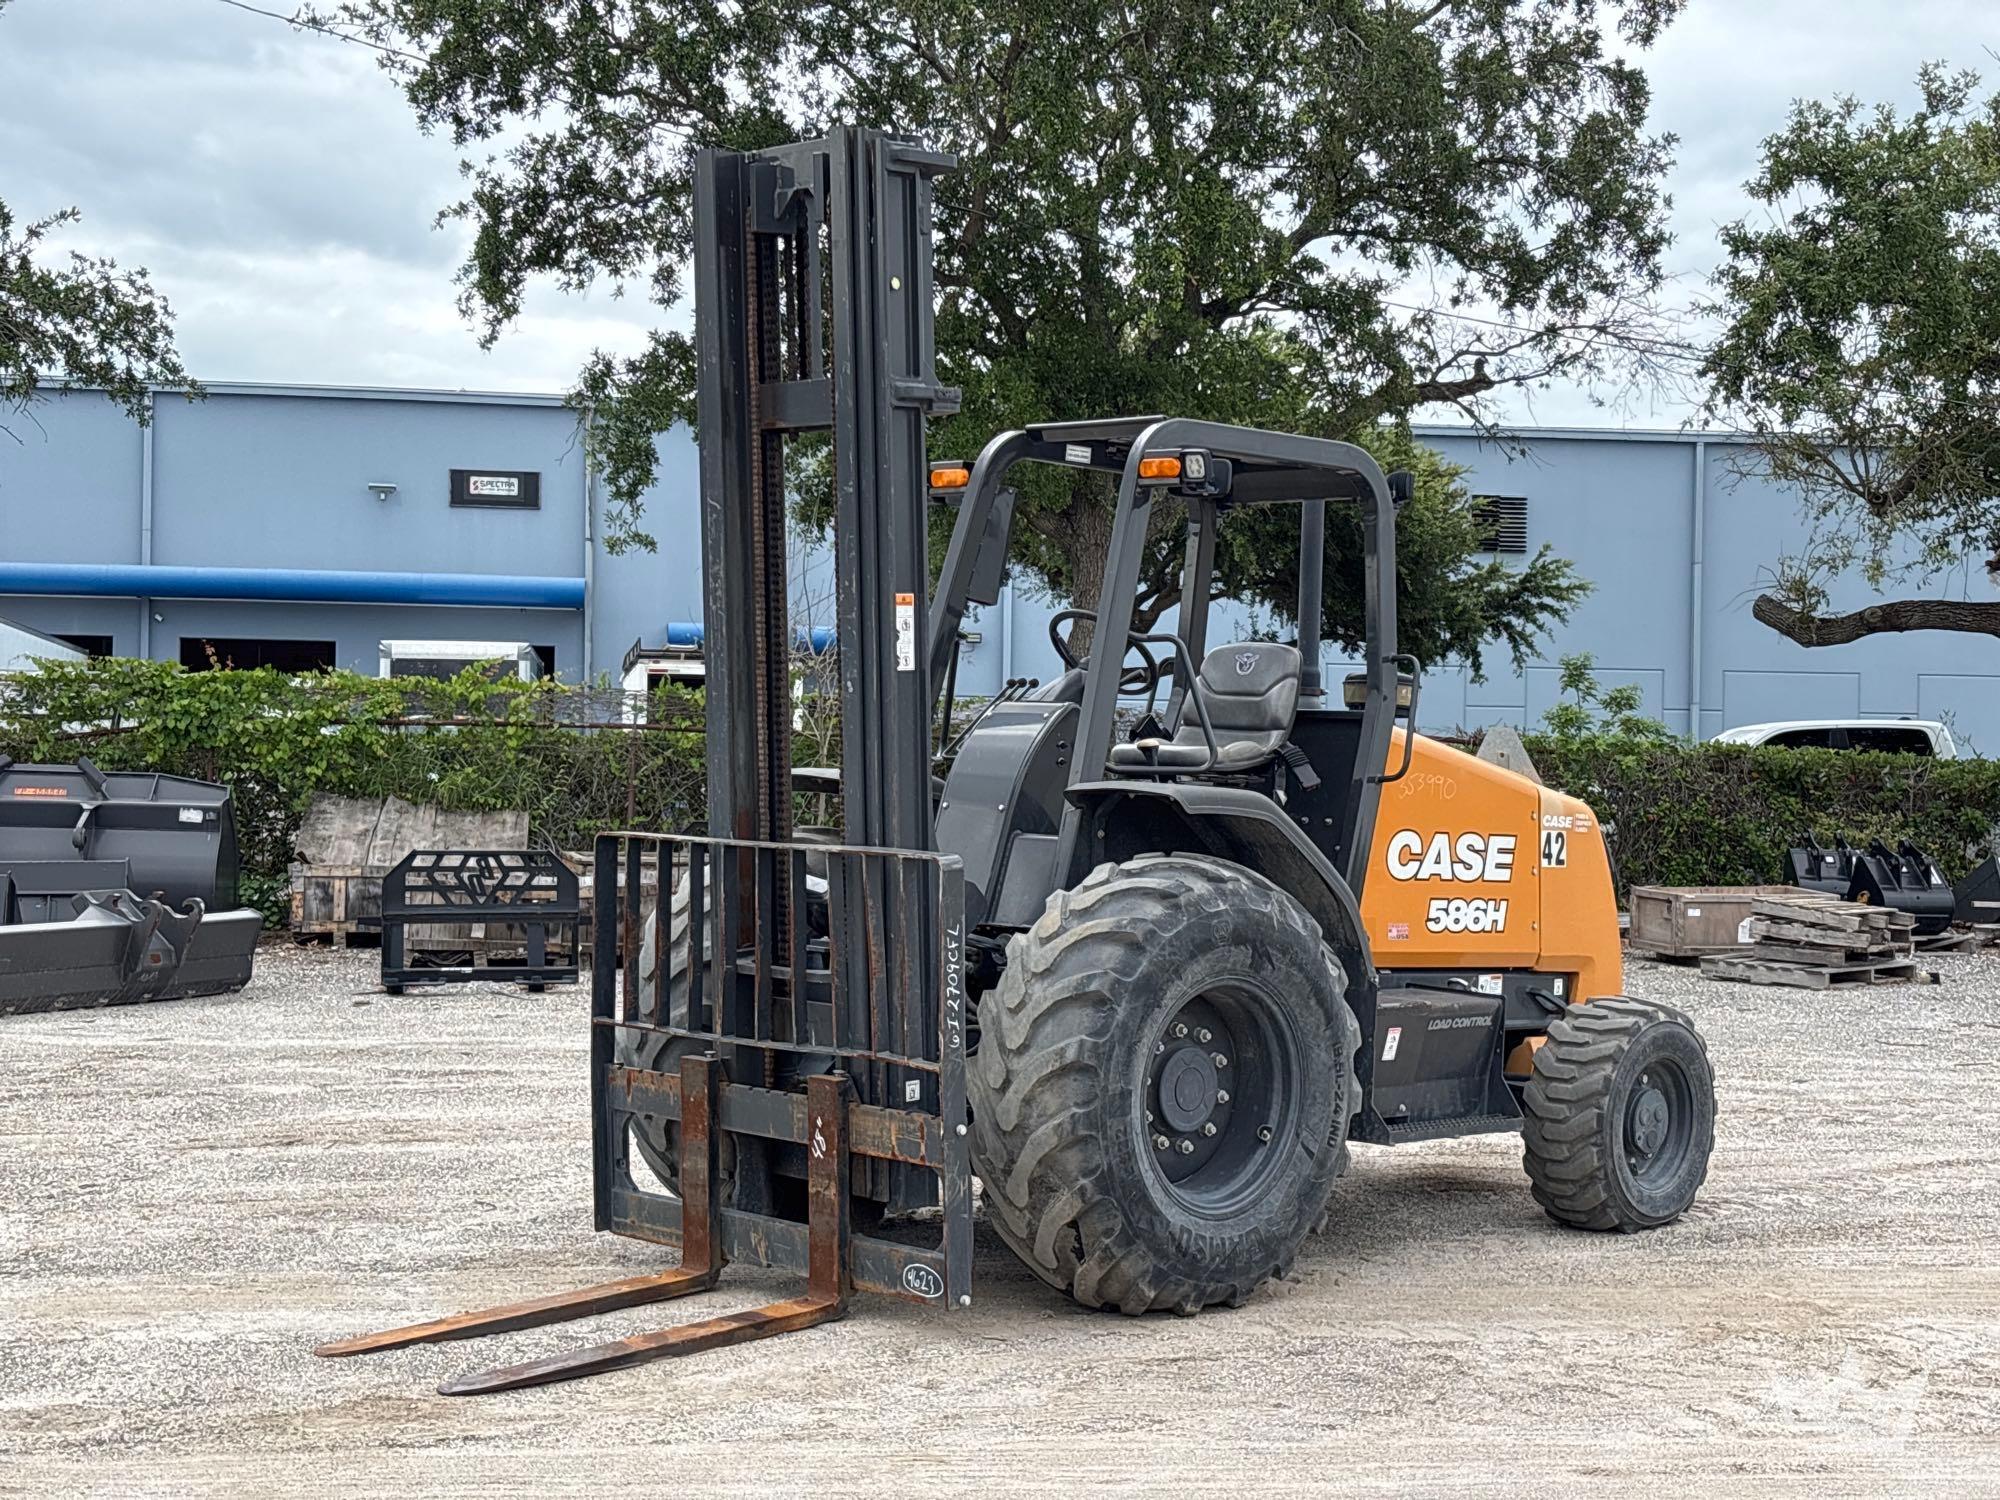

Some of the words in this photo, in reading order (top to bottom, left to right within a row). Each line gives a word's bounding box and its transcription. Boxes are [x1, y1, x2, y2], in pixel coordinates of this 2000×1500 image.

[480, 480, 515, 488] SPECTRA
[1542, 815, 1573, 828] CASE
[1386, 828, 1518, 883] CASE
[1542, 832, 1565, 866] 42
[1425, 897, 1509, 934] 586H
[1427, 1018, 1452, 1030] LOAD
[1452, 1016, 1492, 1028] CONTROL
